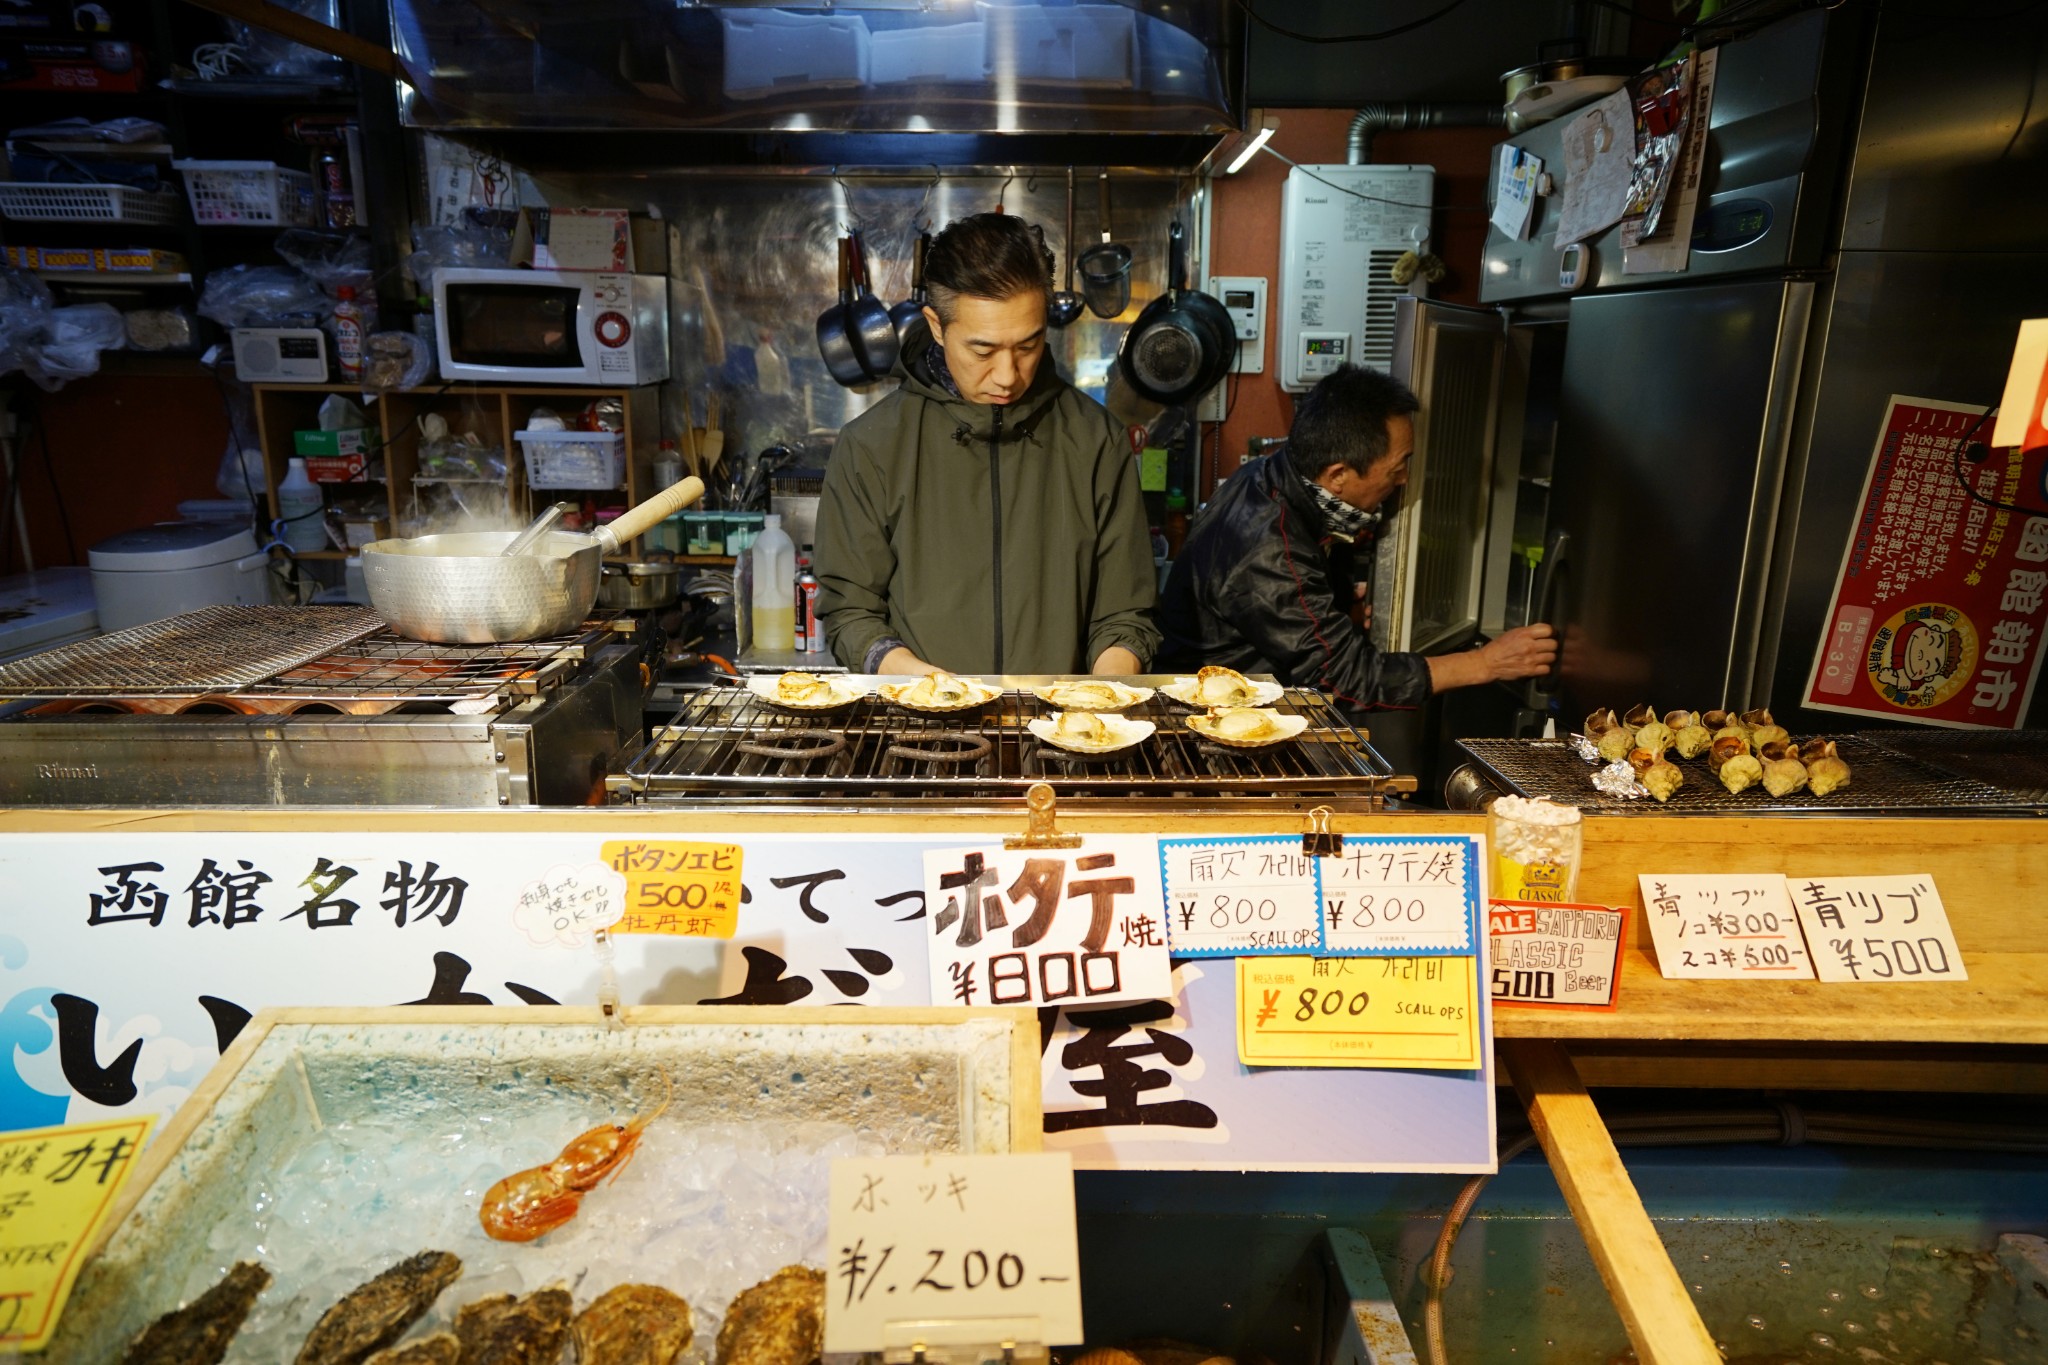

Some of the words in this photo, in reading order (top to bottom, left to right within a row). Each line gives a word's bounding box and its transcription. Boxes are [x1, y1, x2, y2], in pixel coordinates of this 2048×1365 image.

[1865, 411, 1921, 571] 一、元気と笑顔を絶やしません。
[1872, 412, 1936, 605] 一、名刺などの連絡先を渡しています。
[1891, 415, 1952, 597] 一、商品と価格の説明をしています。
[613, 844, 737, 872] ボタンエビ
[1259, 854, 1313, 877] 가리비
[1342, 849, 1458, 885] ホタテ焼
[86, 857, 469, 930] 函館名物
[1518, 888, 1566, 902] CLASSIC
[1652, 882, 1766, 917] 青ツブ
[1803, 882, 1927, 930] 青ツブ
[1490, 913, 1534, 934] ALE
[1535, 908, 1619, 941] SAPPORO
[1382, 957, 1444, 982] 가리비
[1489, 938, 1584, 970] LASSIC
[1829, 937, 1950, 980] ¥500
[947, 951, 1121, 1007] ¥800
[1253, 974, 1296, 985] 税込価格
[1564, 969, 1607, 993] Beer
[852, 1173, 969, 1213] ホッキ
